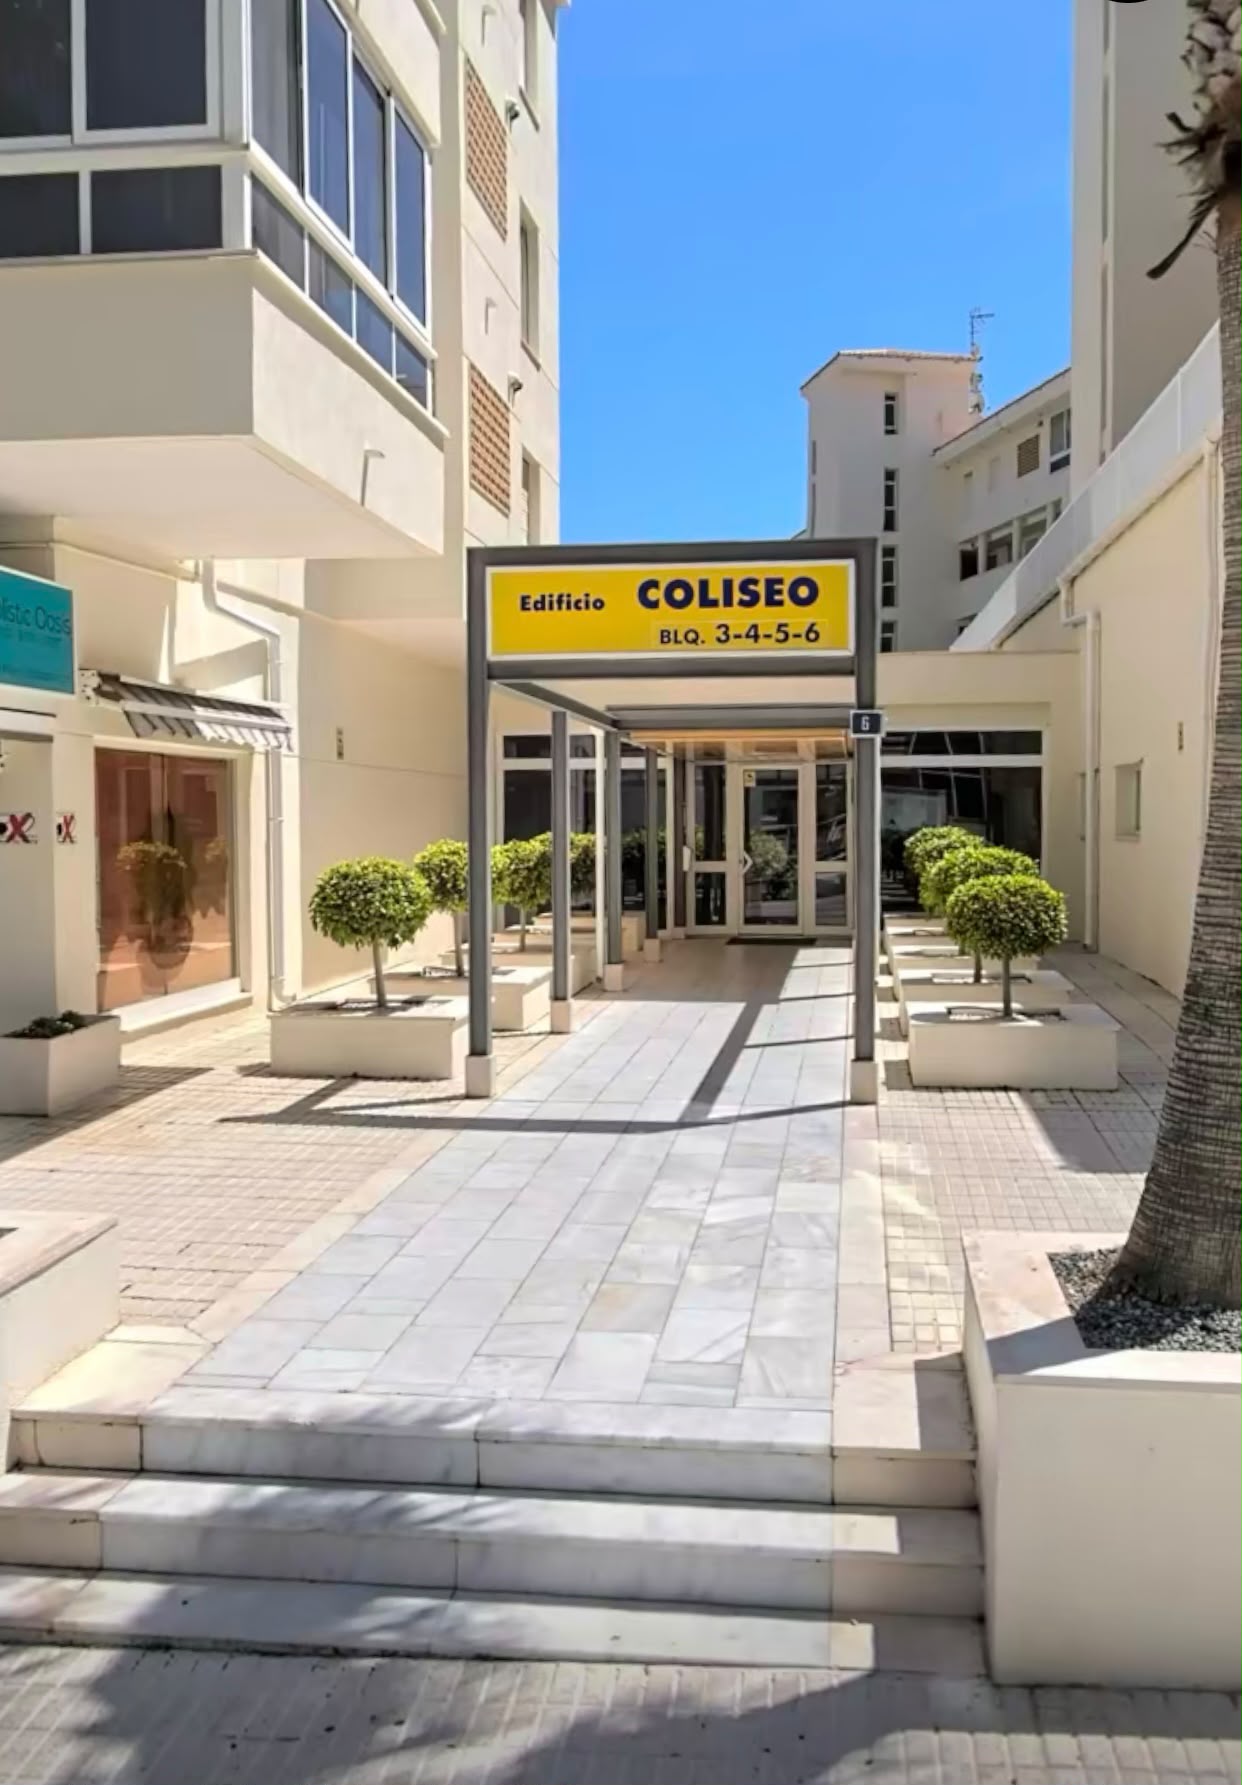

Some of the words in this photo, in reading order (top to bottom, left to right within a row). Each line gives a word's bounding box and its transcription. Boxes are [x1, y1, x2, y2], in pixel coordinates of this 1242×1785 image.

[520, 593, 605, 611] Edificio
[637, 576, 819, 610] COLISEO
[660, 628, 705, 646] BLQ.
[715, 622, 820, 644] 3-4-5-6
[861, 715, 870, 731] 6
